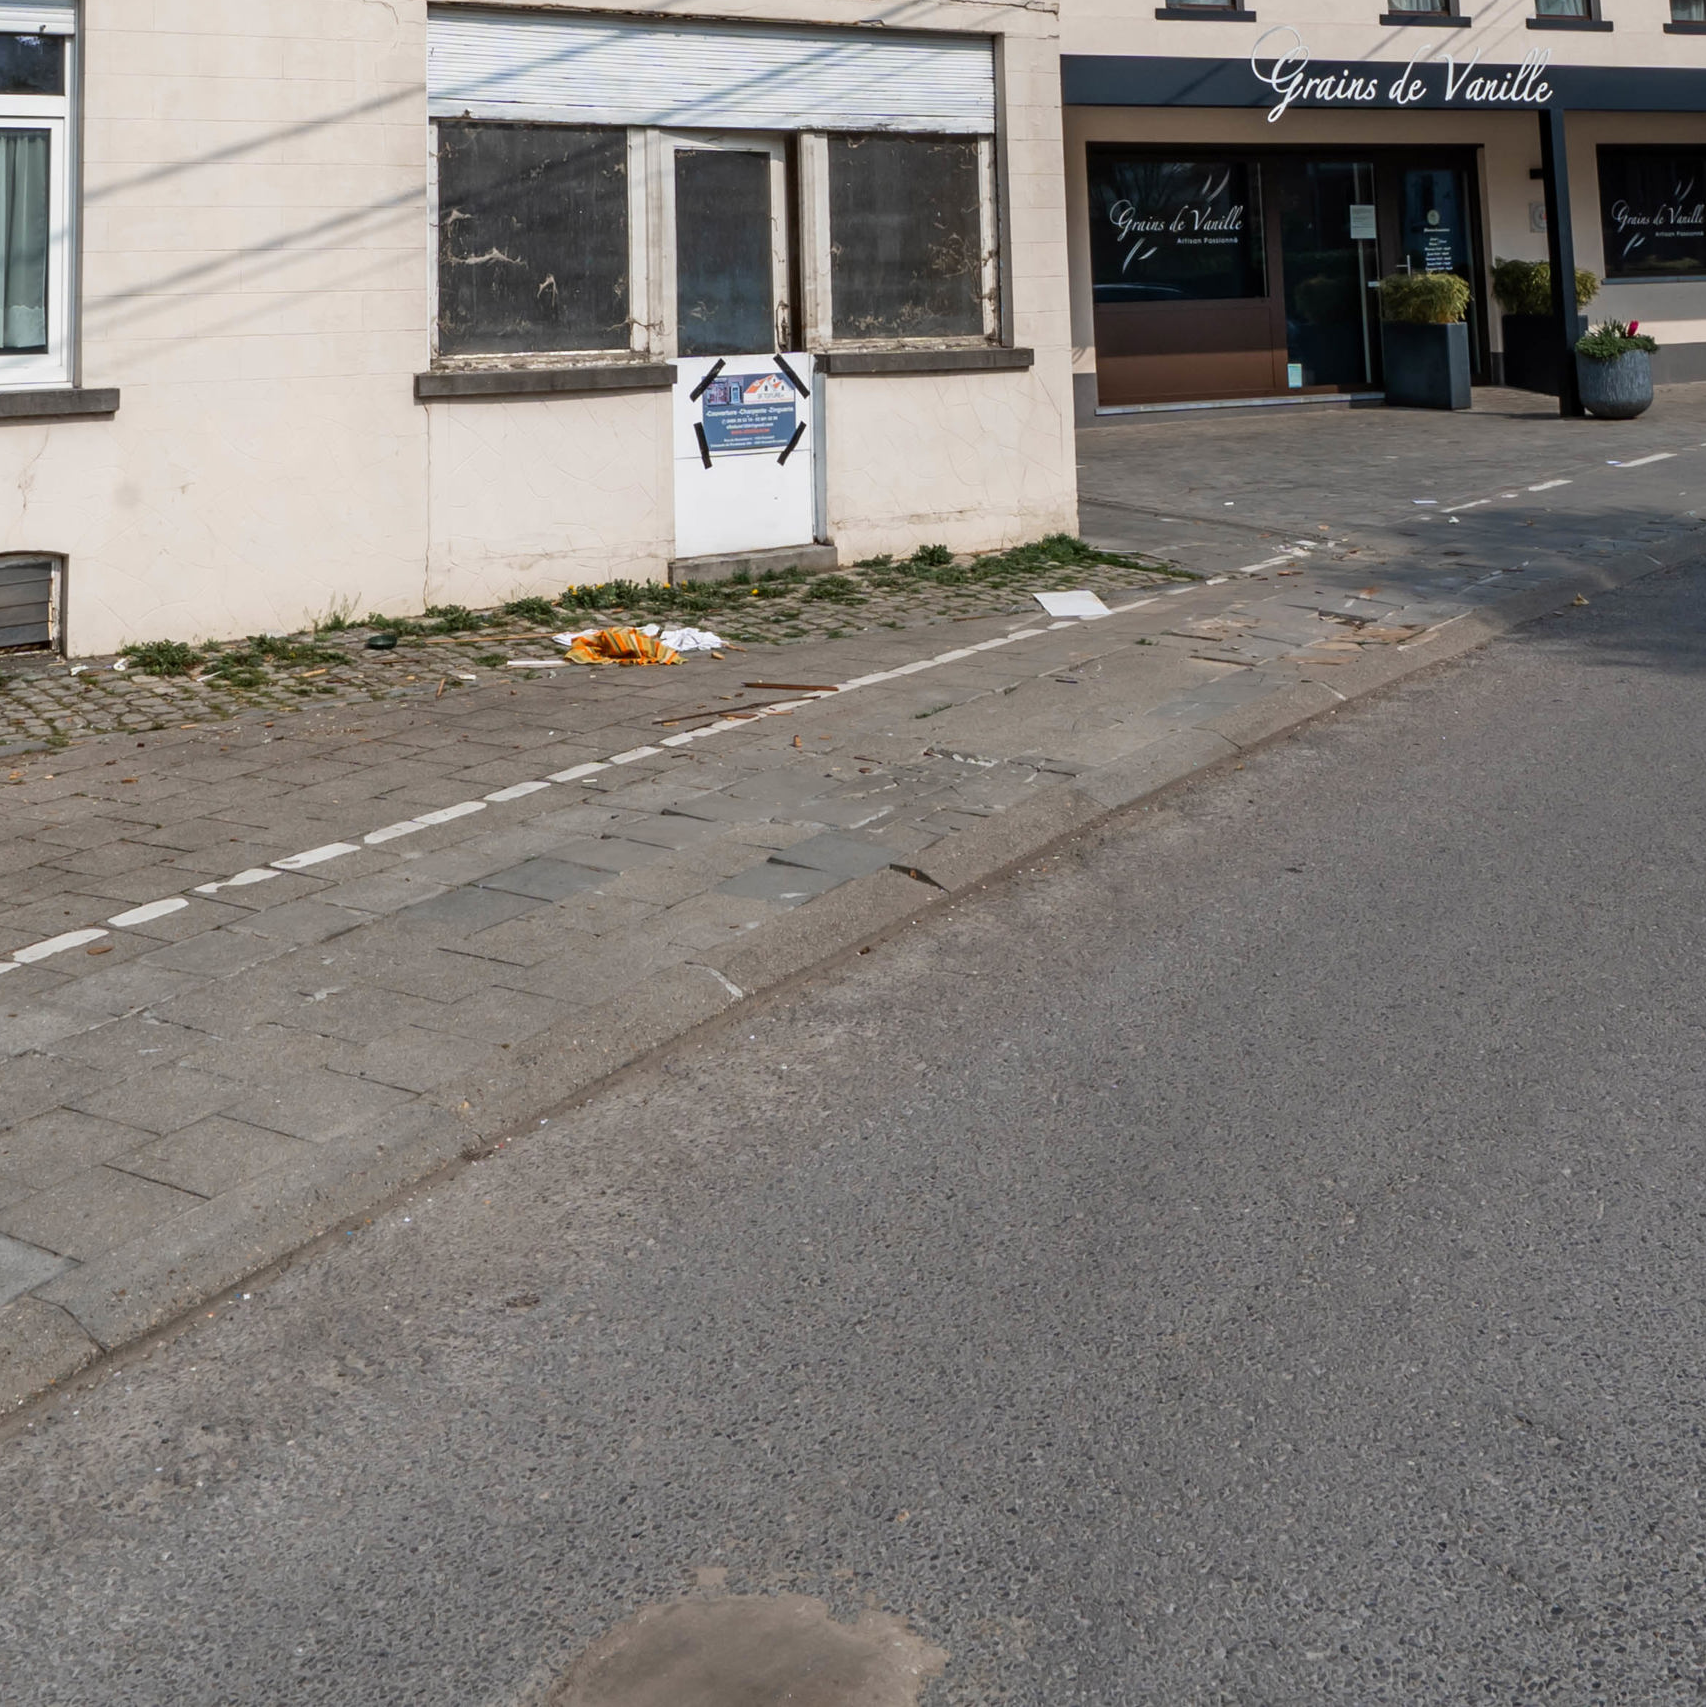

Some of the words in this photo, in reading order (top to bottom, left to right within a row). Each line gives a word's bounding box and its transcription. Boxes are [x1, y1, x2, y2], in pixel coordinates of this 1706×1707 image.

[1250, 25, 1378, 123] Grains
[1388, 44, 1431, 105] de
[1437, 46, 1554, 103] Vanille
[1109, 199, 1165, 242] Grains
[1169, 204, 1189, 233] de
[1190, 205, 1243, 231] Vanille
[1611, 199, 1650, 233] Grains
[1653, 203, 1667, 226] de
[1668, 204, 1705, 225] Vanille
[1176, 236, 1202, 244] Artisan
